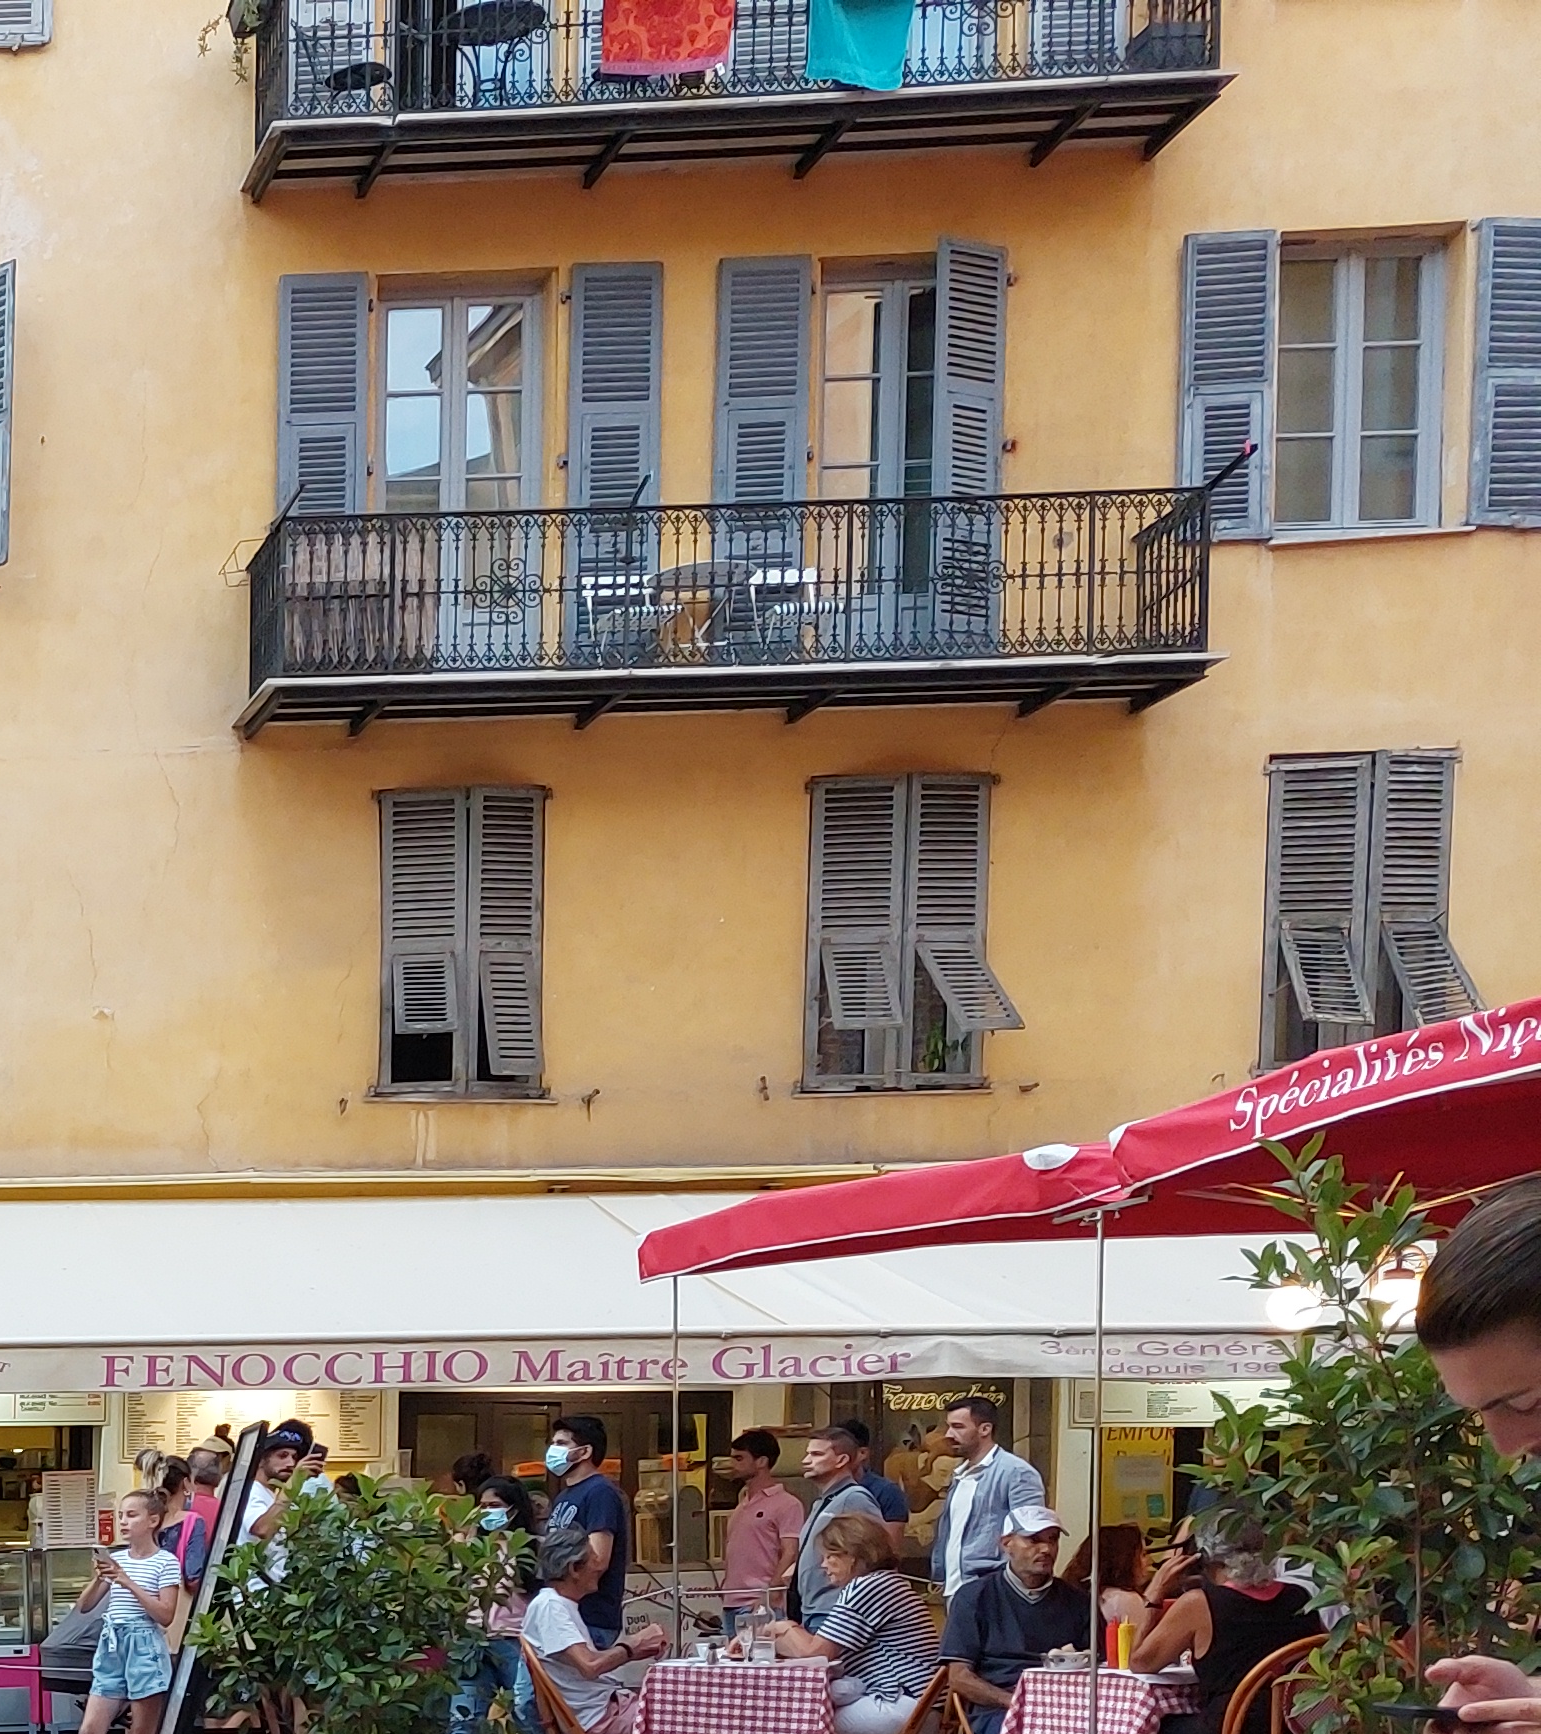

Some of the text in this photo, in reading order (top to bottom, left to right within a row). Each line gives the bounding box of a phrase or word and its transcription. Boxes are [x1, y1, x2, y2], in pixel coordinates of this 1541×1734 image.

[1229, 1031, 1445, 1139] Spécialités
[99, 1343, 913, 1388] FENOCCHIO Maître Glacier
[1108, 1361, 1280, 1376] depuis 196
